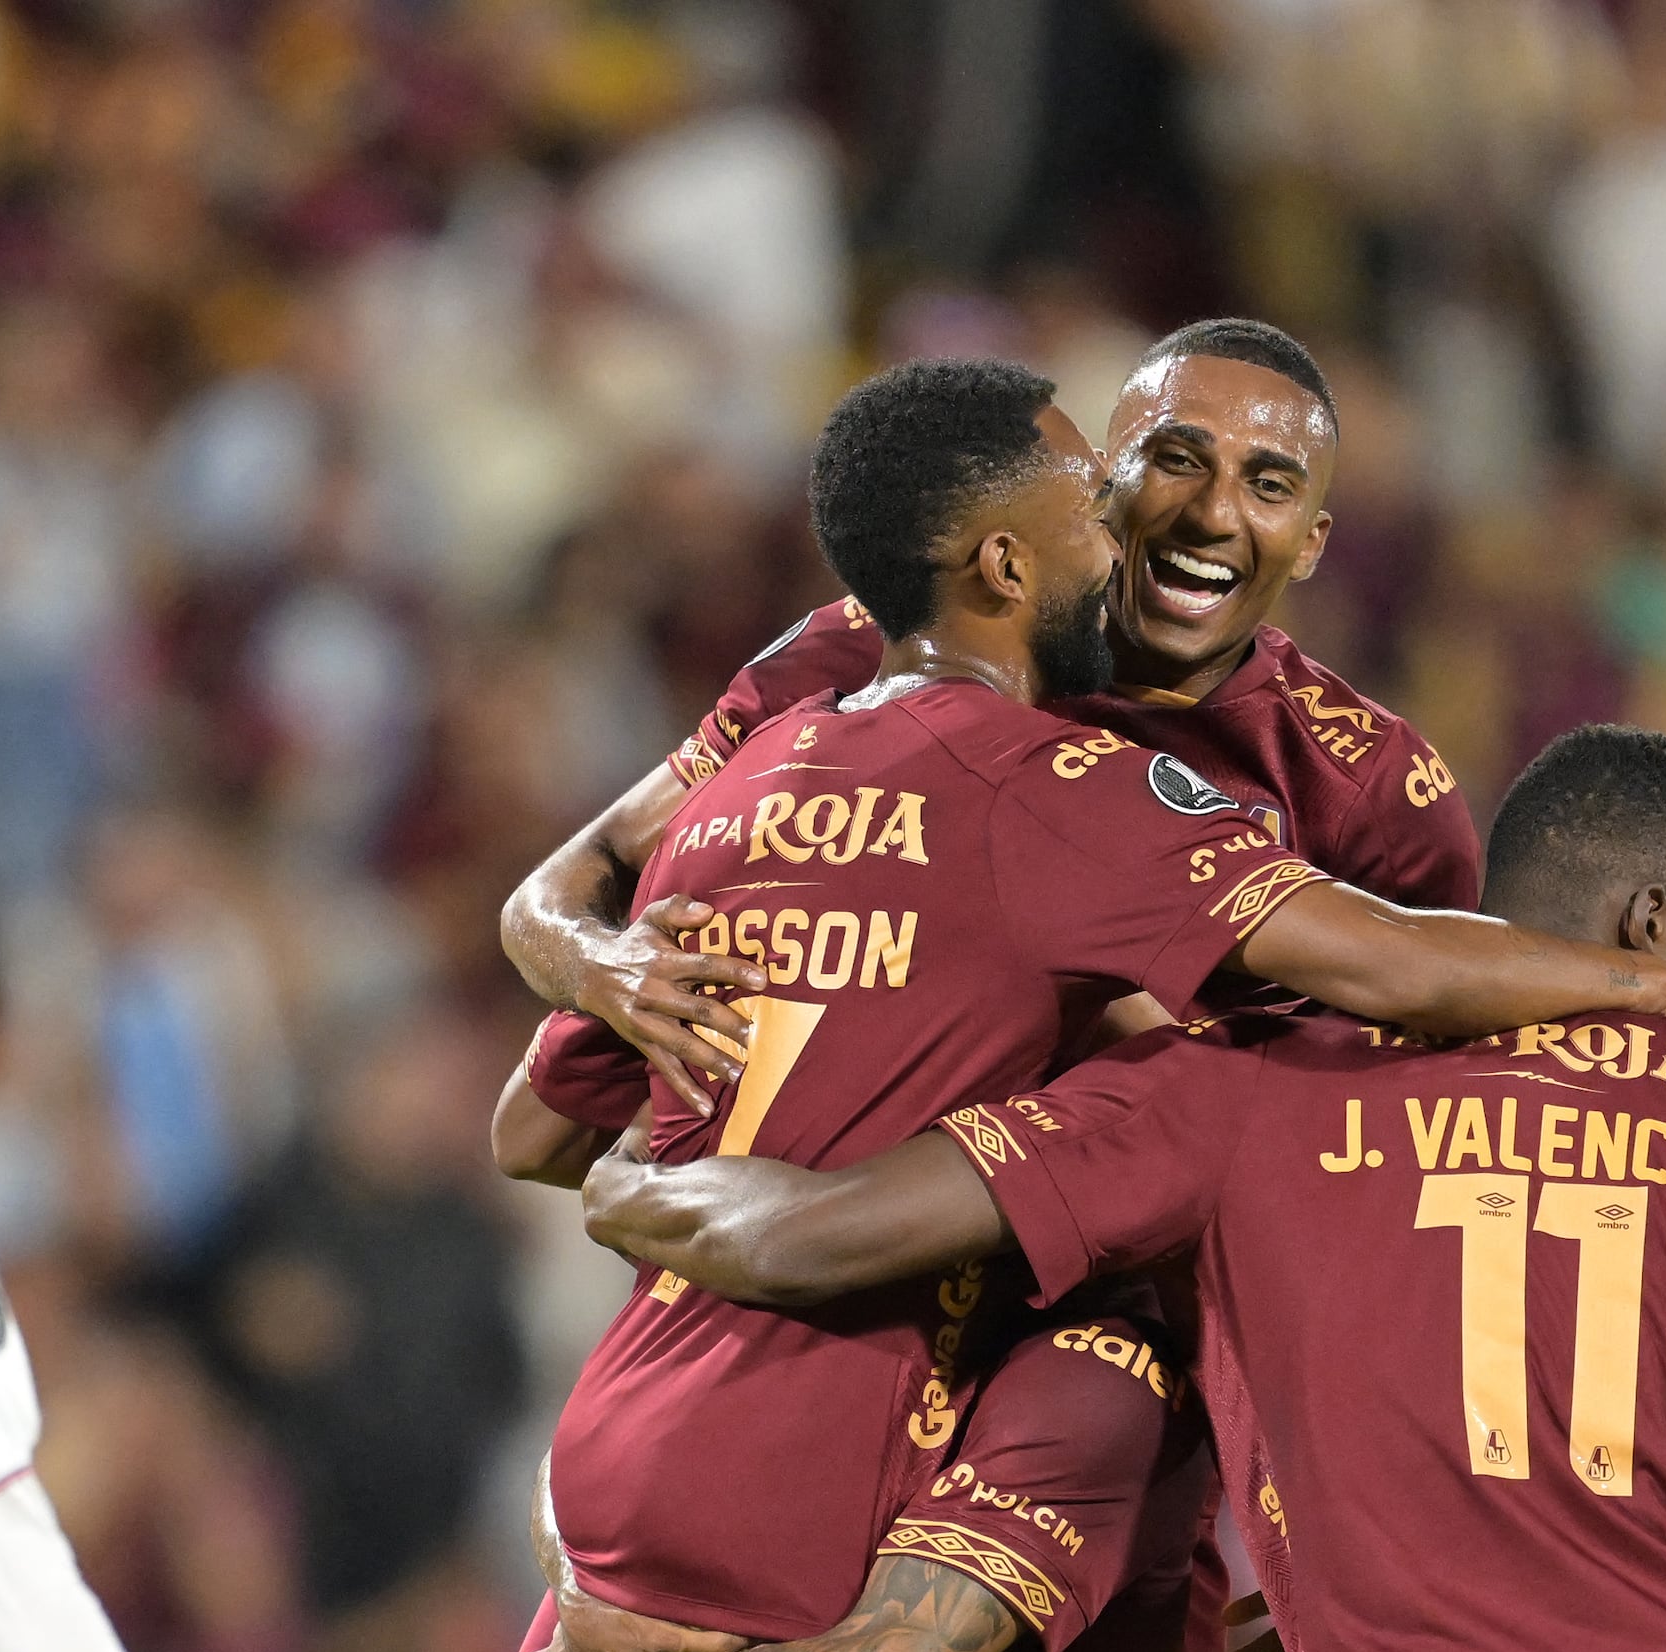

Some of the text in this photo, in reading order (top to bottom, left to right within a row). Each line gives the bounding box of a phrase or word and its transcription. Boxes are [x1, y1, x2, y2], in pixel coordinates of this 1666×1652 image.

[670, 787, 930, 866] TAPA ROJA
[1319, 1098, 1384, 1173] J.
[1478, 1209, 1512, 1219] umbro
[1597, 1221, 1630, 1230] umbro
[1413, 1173, 1649, 1497] 11
[970, 1481, 1085, 1557] HOLCIM
